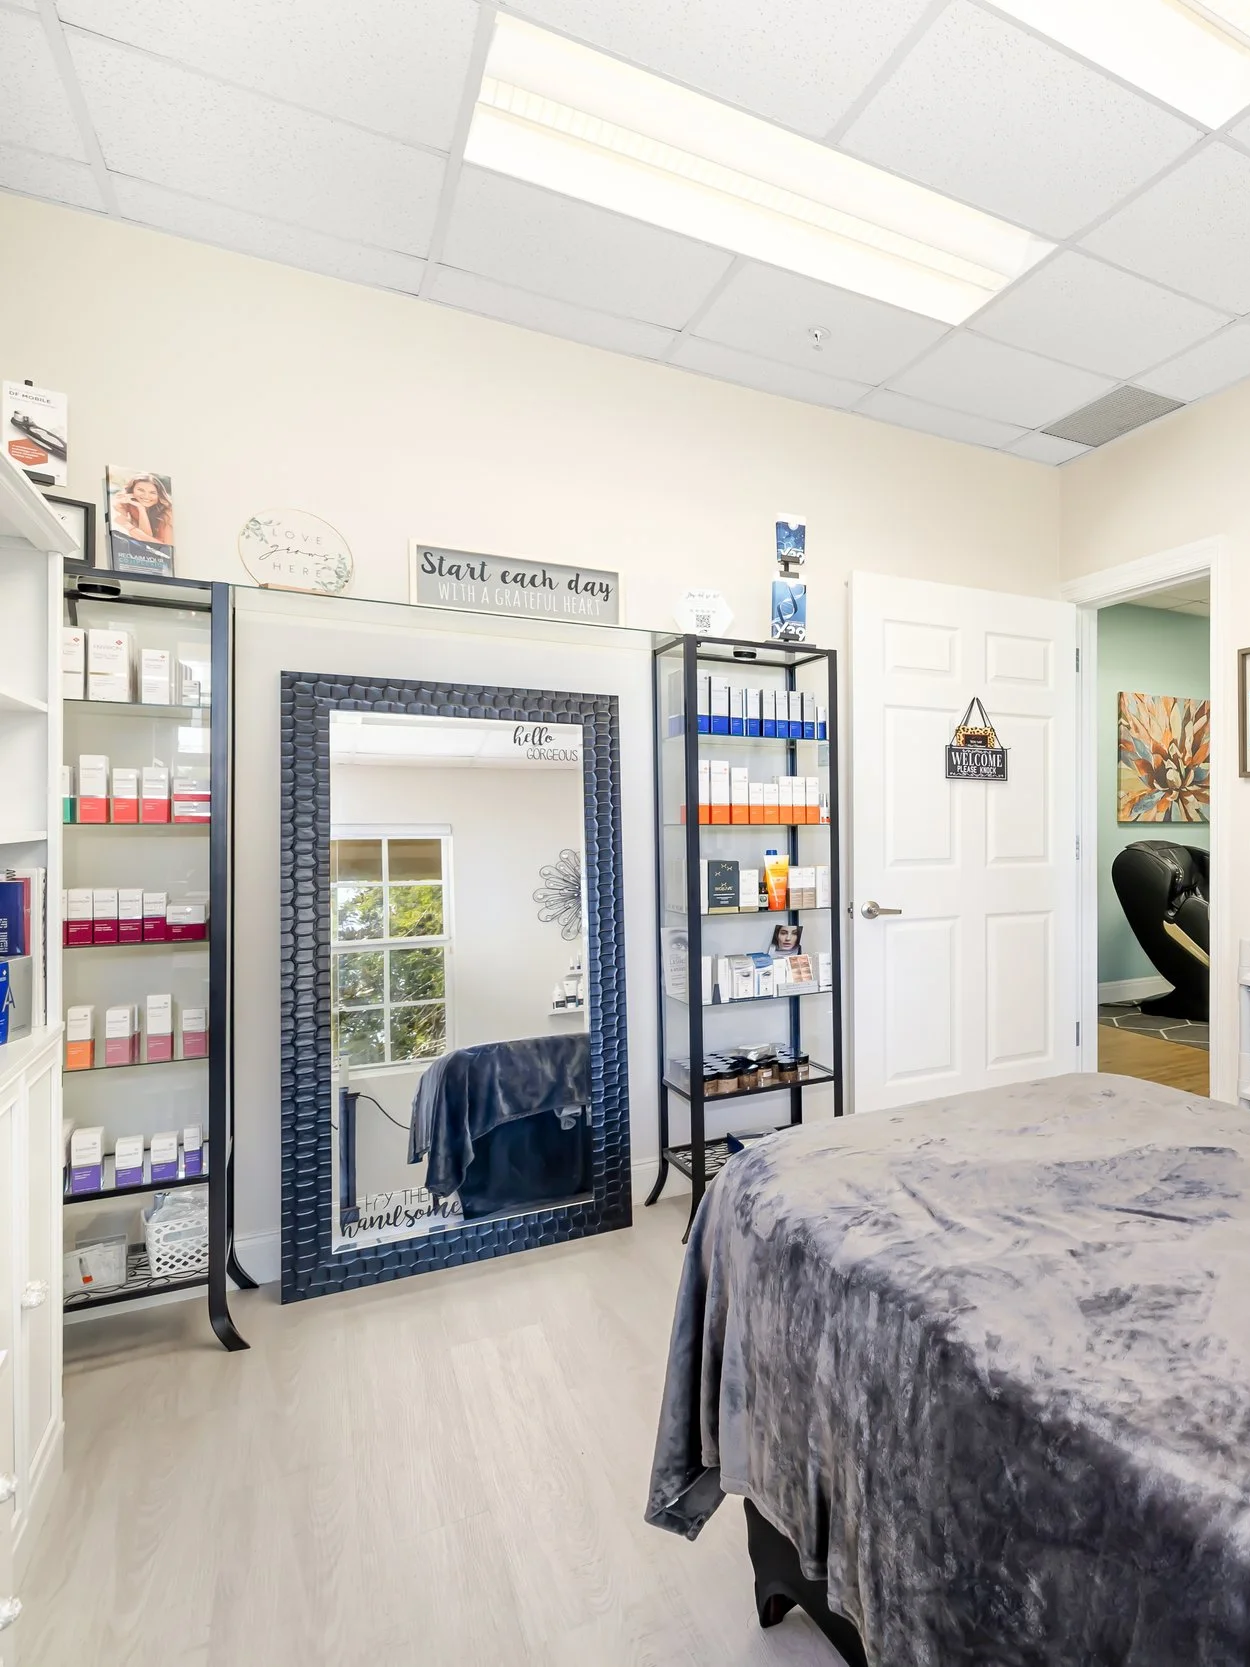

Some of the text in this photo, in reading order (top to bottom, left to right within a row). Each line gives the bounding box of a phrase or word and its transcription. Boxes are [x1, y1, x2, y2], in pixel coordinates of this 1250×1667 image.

[272, 528, 321, 545] LOVE
[272, 562, 321, 578] HERE
[421, 551, 614, 602] Start each day
[438, 581, 601, 616] WITH A GRATEFUL HEART
[513, 725, 556, 747] hello
[526, 747, 579, 762] GORGEOUS
[951, 751, 1003, 768] WELCOME
[956, 765, 997, 775] PLEASE KNOCK
[341, 1199, 464, 1239] handsome
